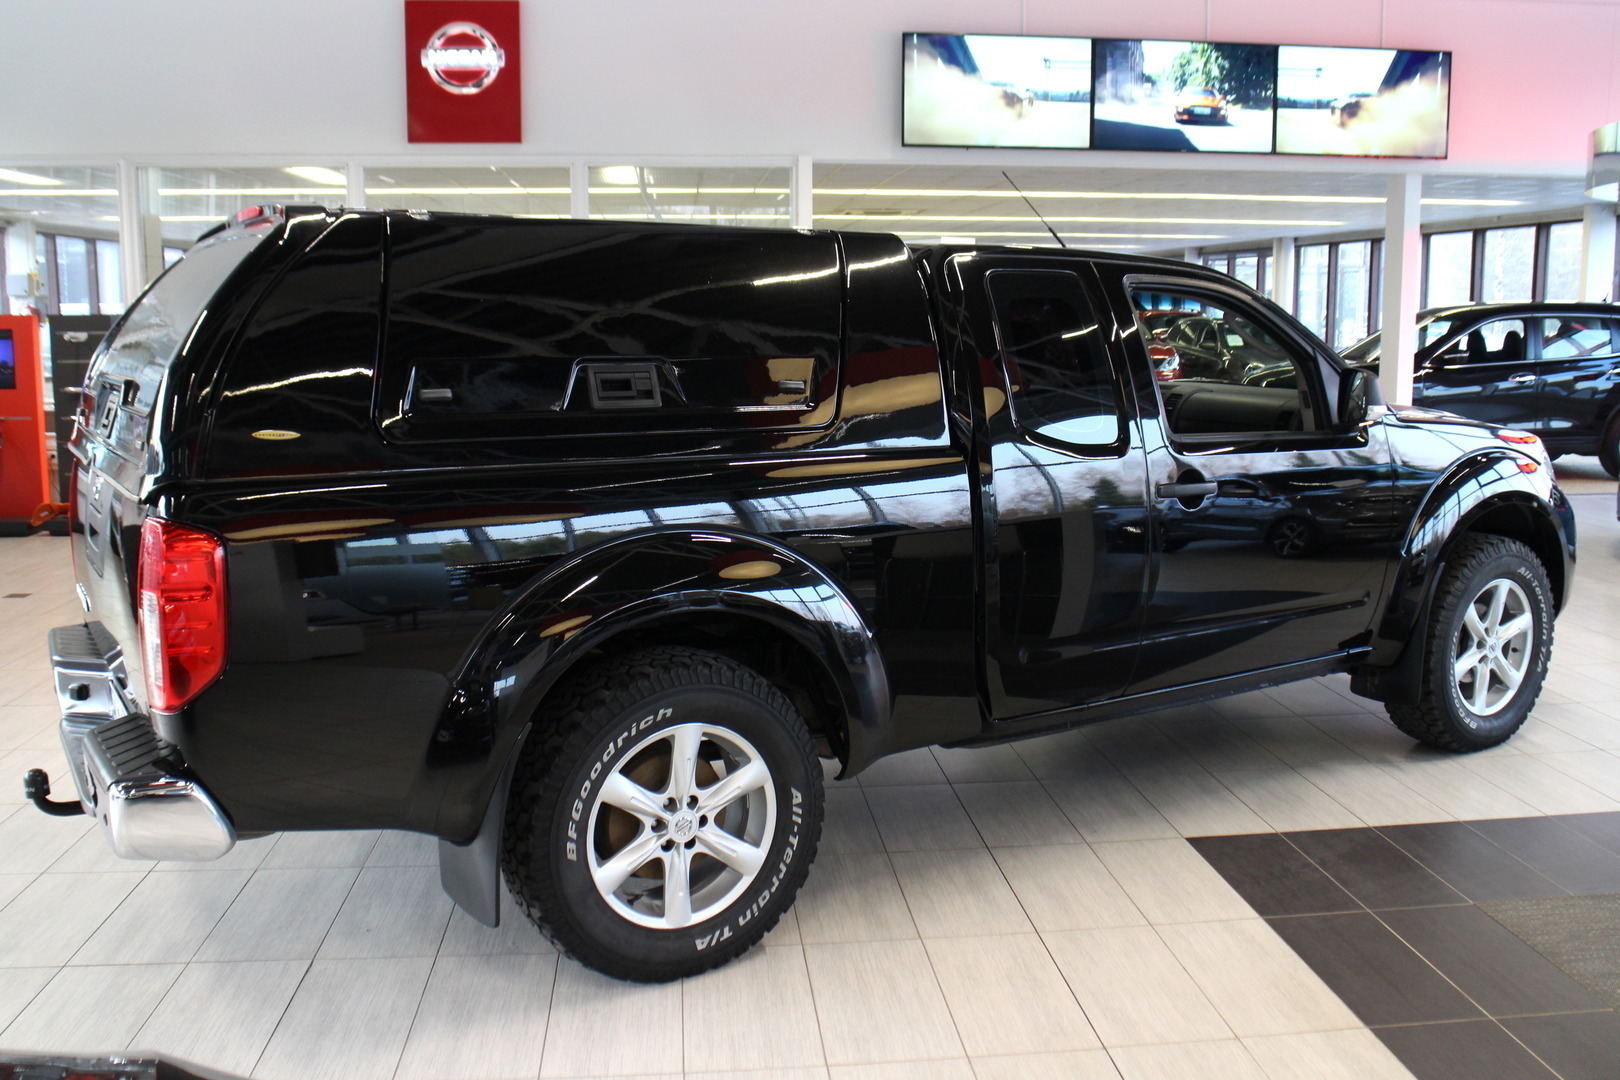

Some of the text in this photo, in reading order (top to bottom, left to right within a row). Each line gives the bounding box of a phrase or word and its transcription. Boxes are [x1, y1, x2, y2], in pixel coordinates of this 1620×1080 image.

[1517, 566, 1548, 640] All-Terrain
[566, 707, 673, 862] BFGoodrich
[694, 786, 804, 952] All-Terrain T/A
